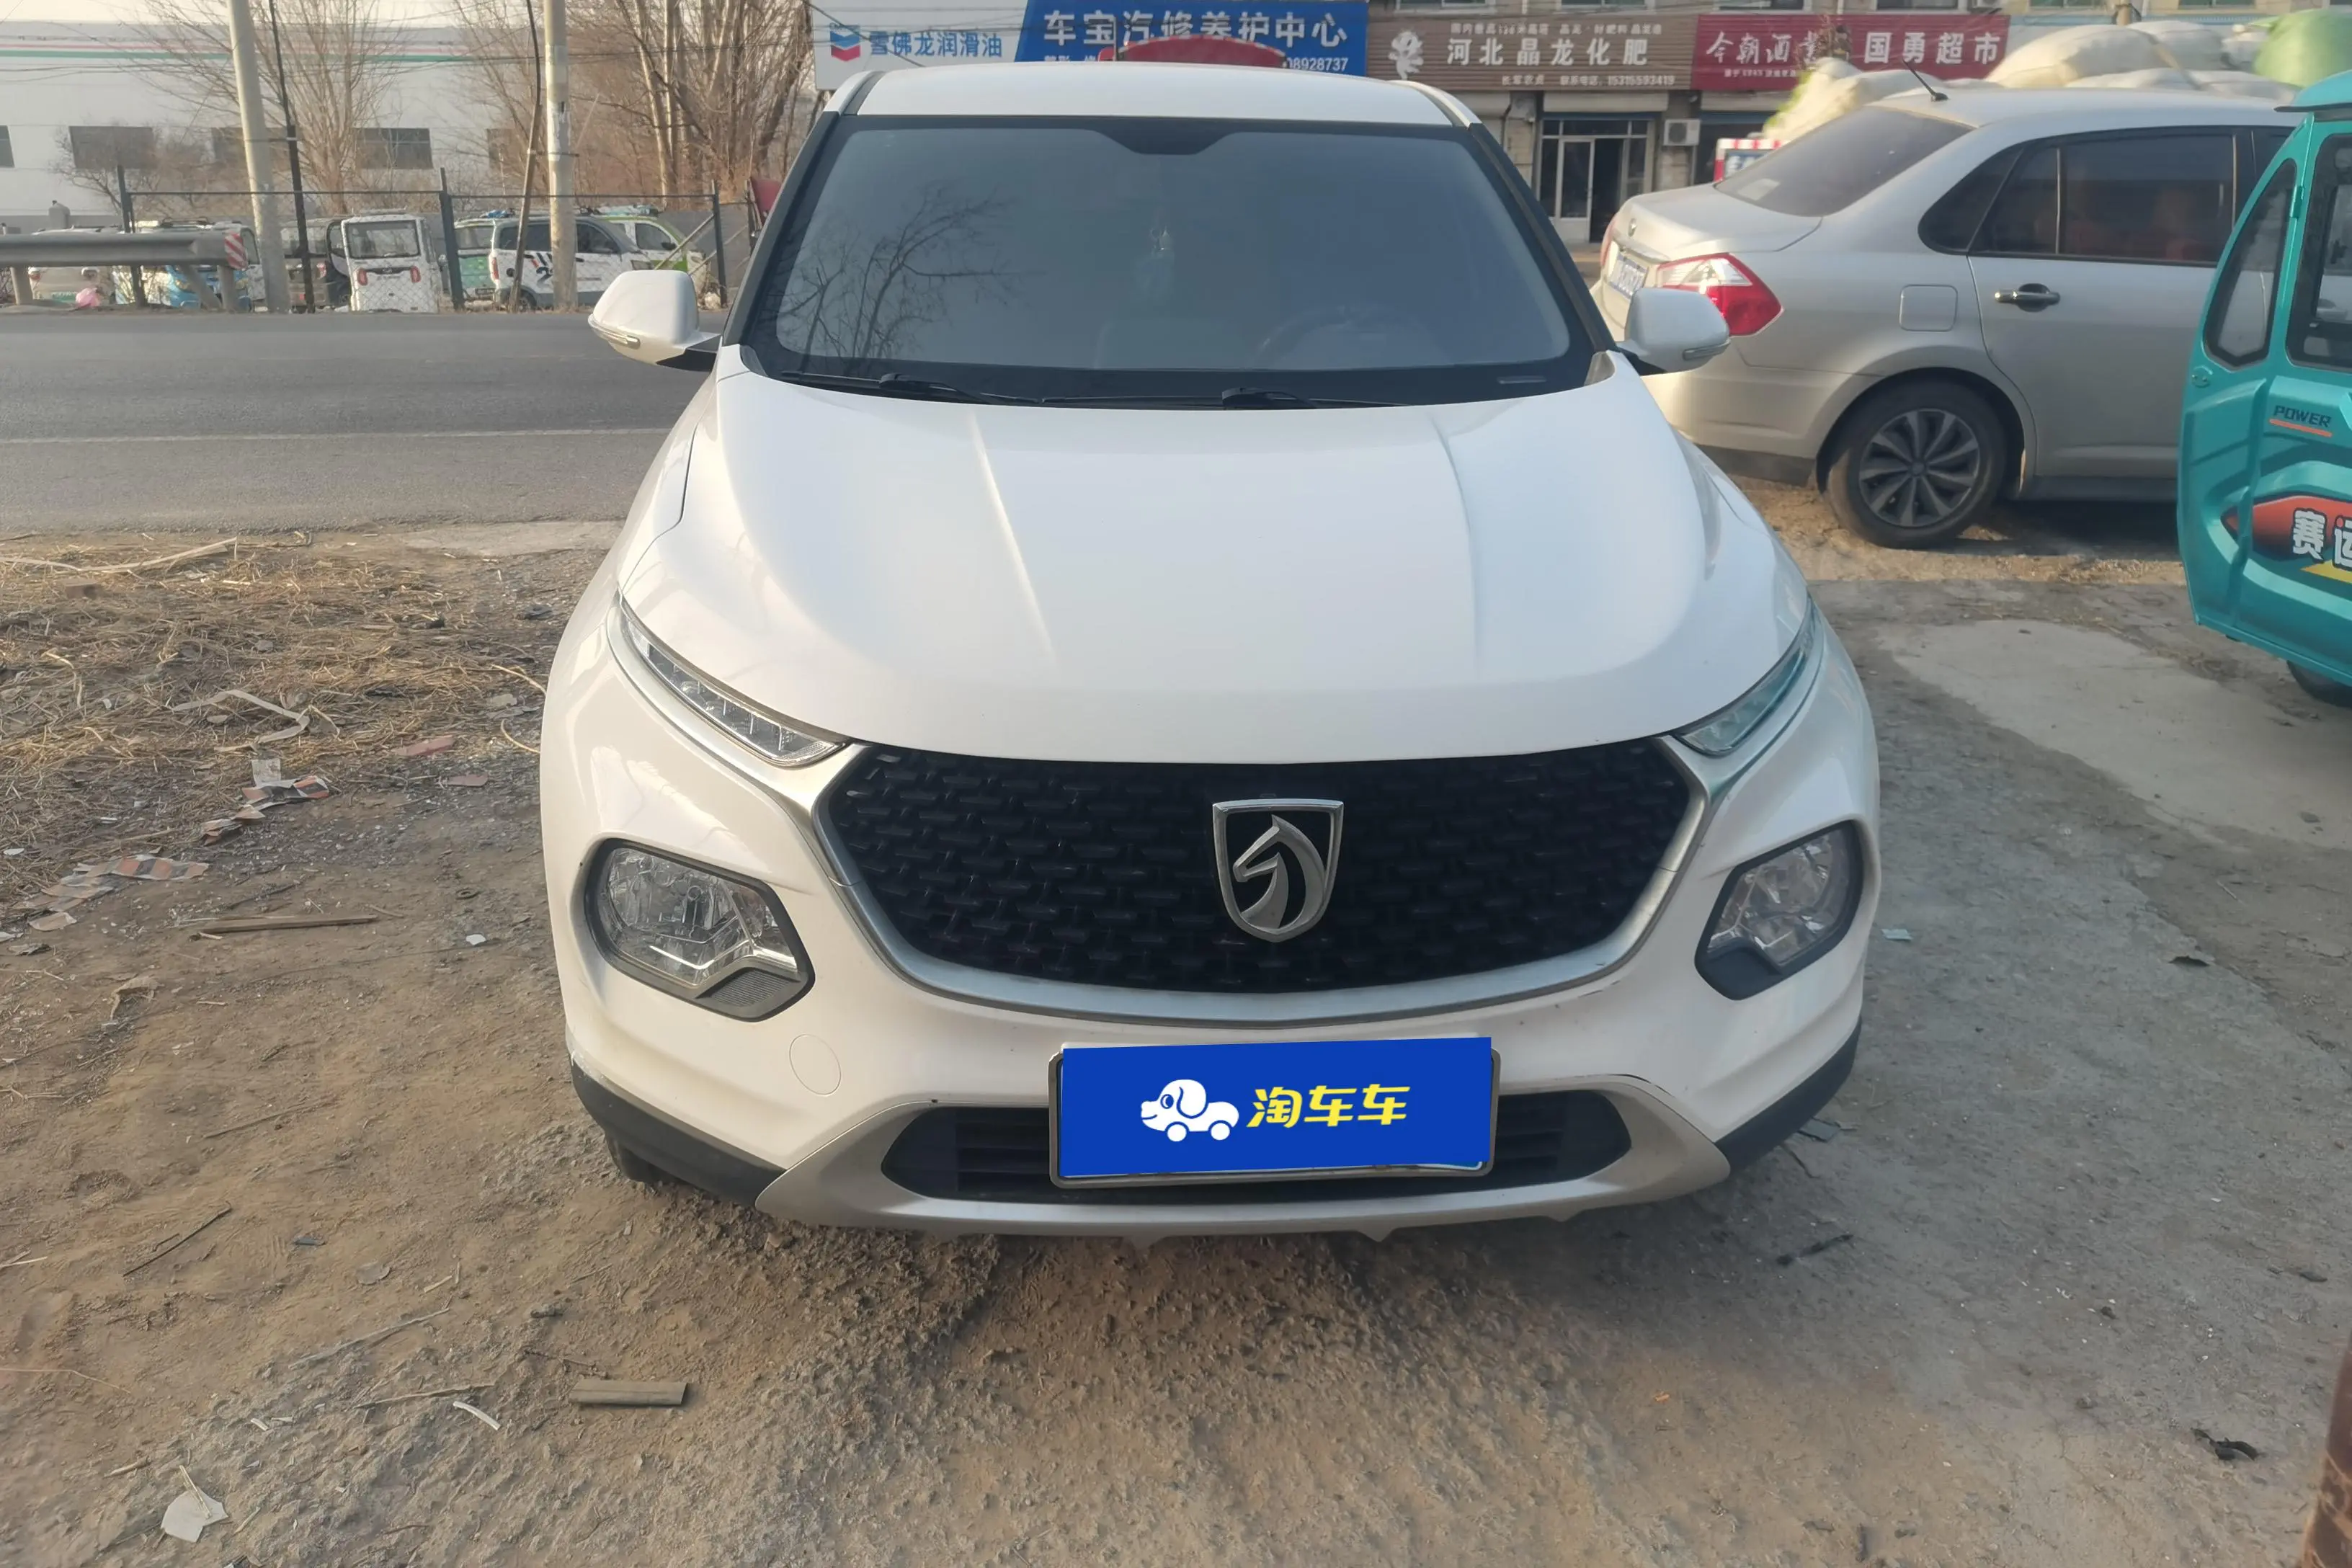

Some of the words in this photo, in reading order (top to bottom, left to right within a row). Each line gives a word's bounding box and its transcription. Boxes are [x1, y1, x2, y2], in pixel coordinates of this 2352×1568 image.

[1044, 9, 1348, 48] 车宝汽修养护中心
[869, 30, 1002, 58] 雪佛龙润滑油
[1447, 37, 1647, 66] 河北晶龙化肥
[1863, 32, 2000, 65] 国勇超市
[2273, 404, 2332, 428] POWER
